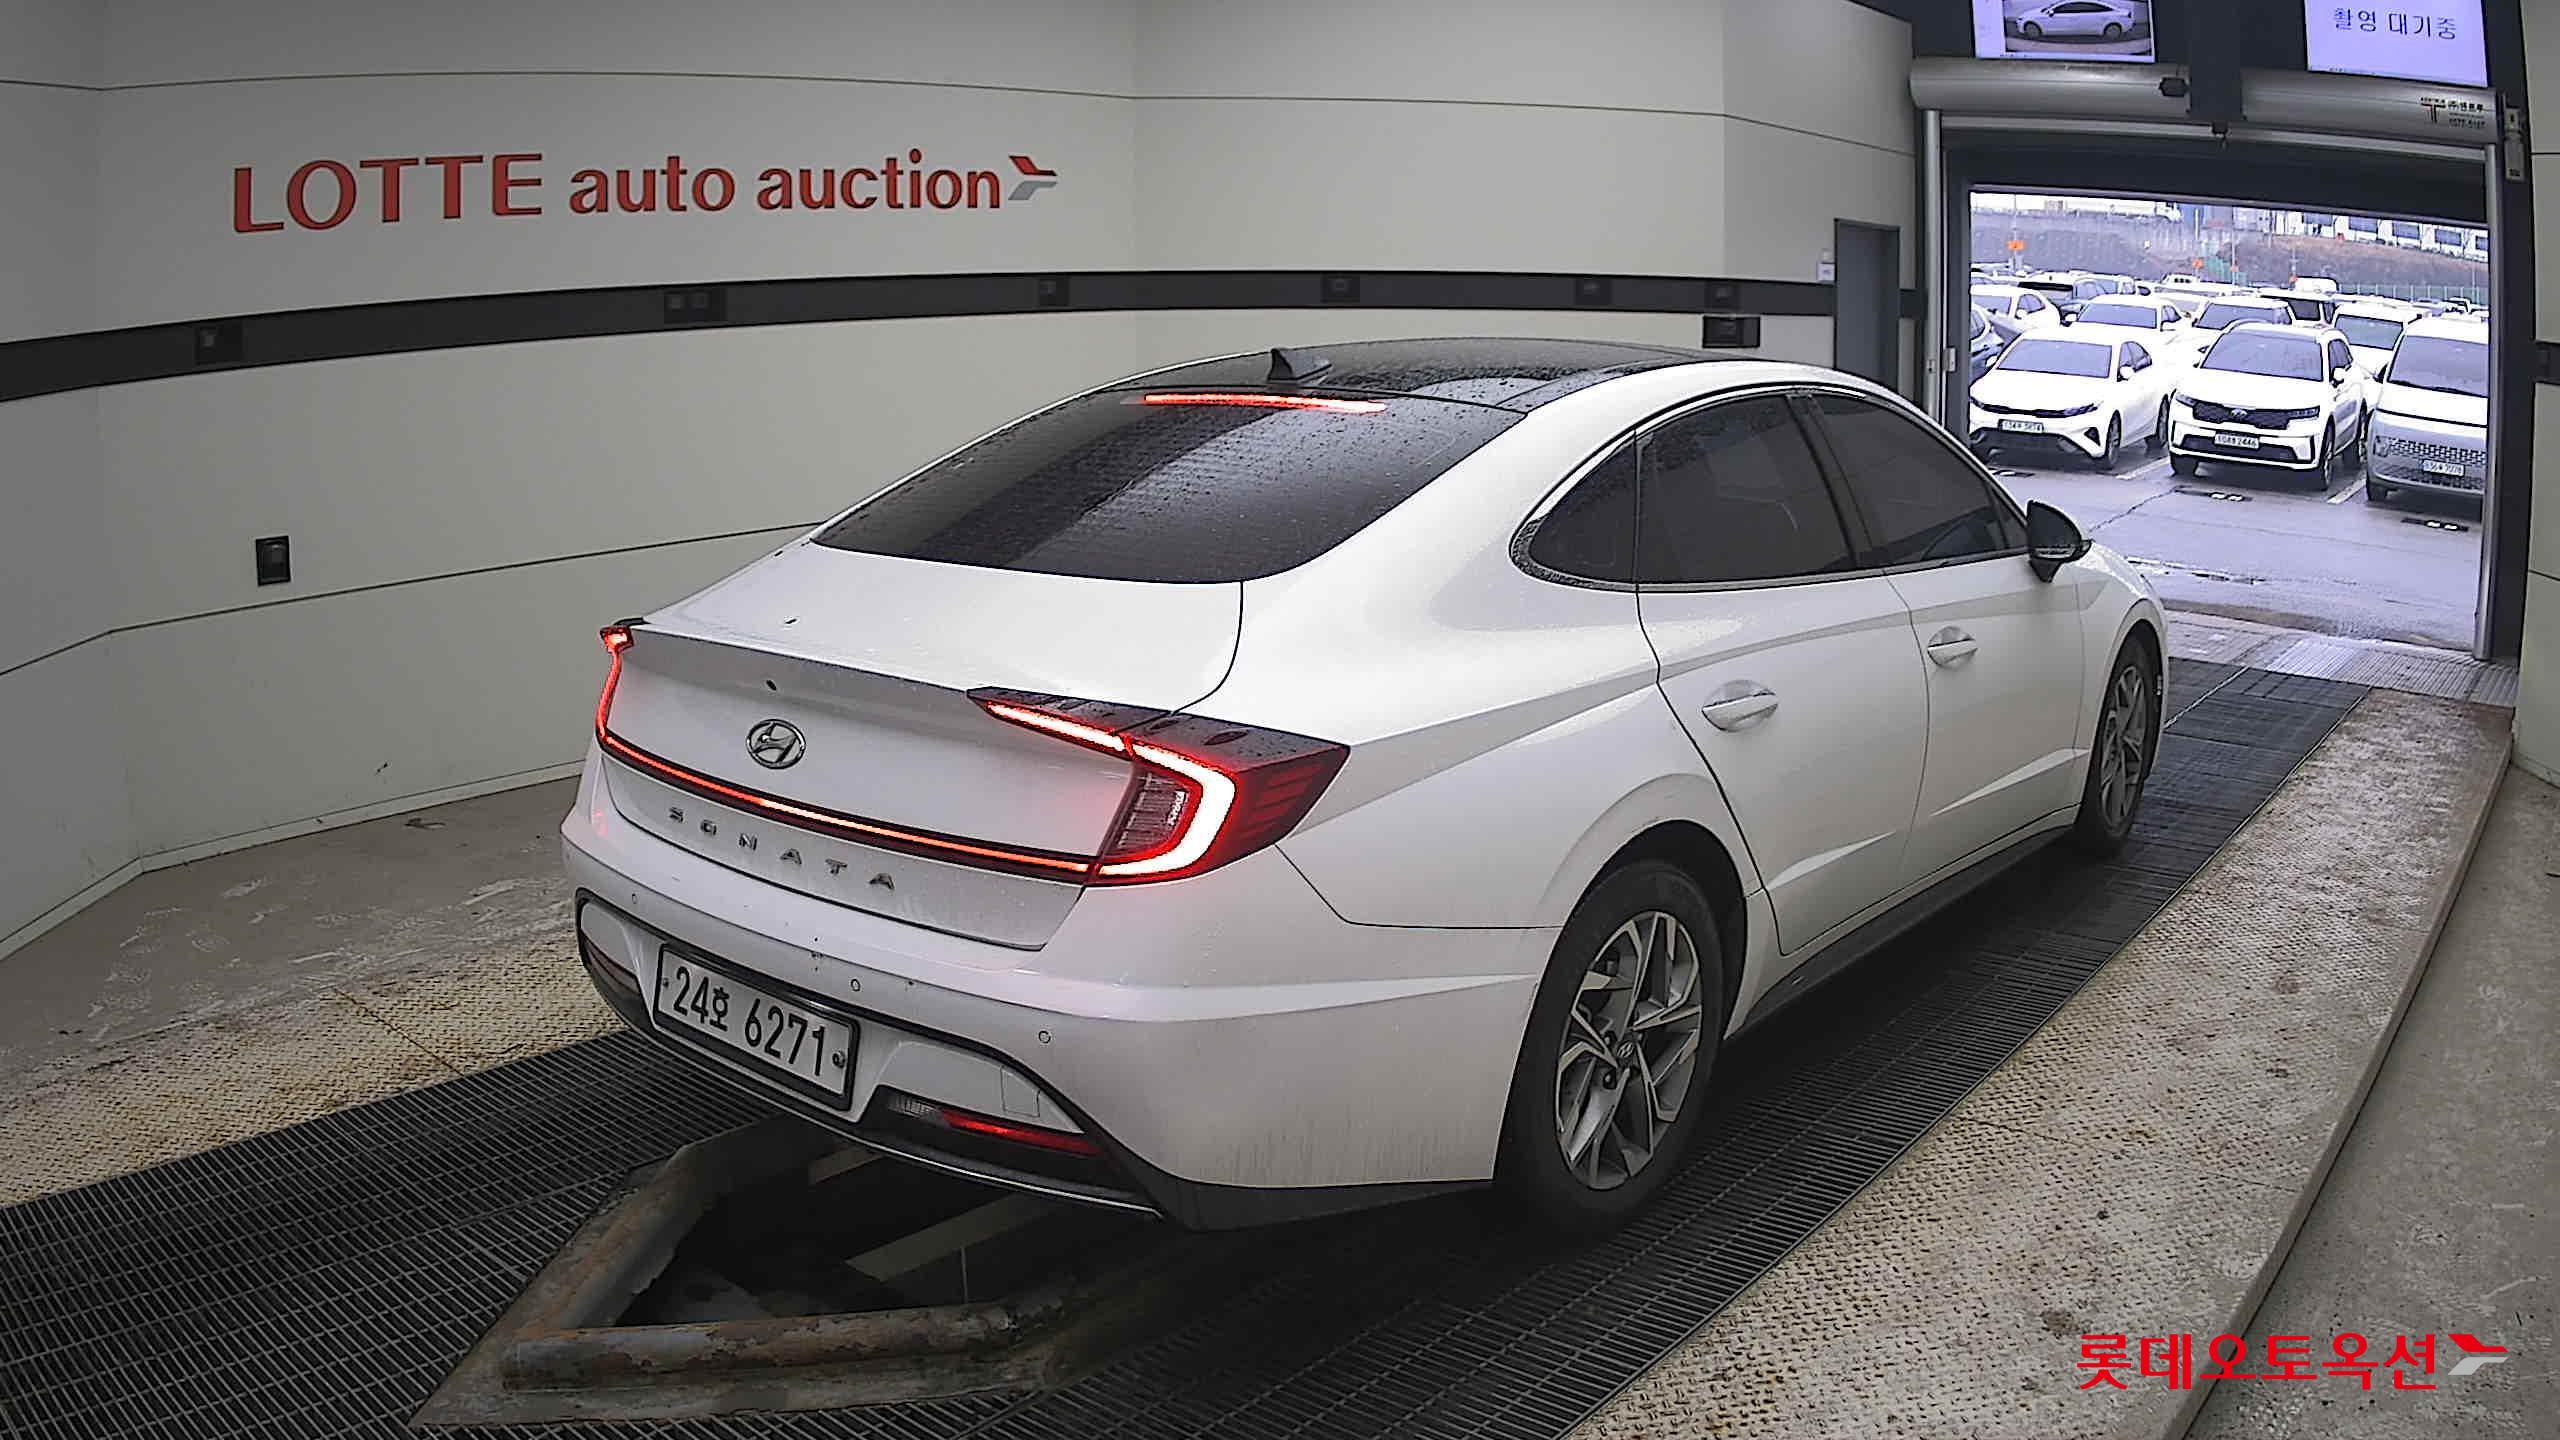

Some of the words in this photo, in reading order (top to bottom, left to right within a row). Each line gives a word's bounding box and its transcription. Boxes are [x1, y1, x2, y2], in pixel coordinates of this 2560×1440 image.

[2334, 7, 2376, 33] 촬영
[2388, 13, 2457, 40] 대기중
[233, 153, 543, 233] LOTTE
[568, 155, 736, 214] auto
[756, 148, 1001, 210] auction
[669, 806, 896, 891] SONATA
[673, 965, 730, 1032] 24호
[744, 997, 827, 1077] 6271
